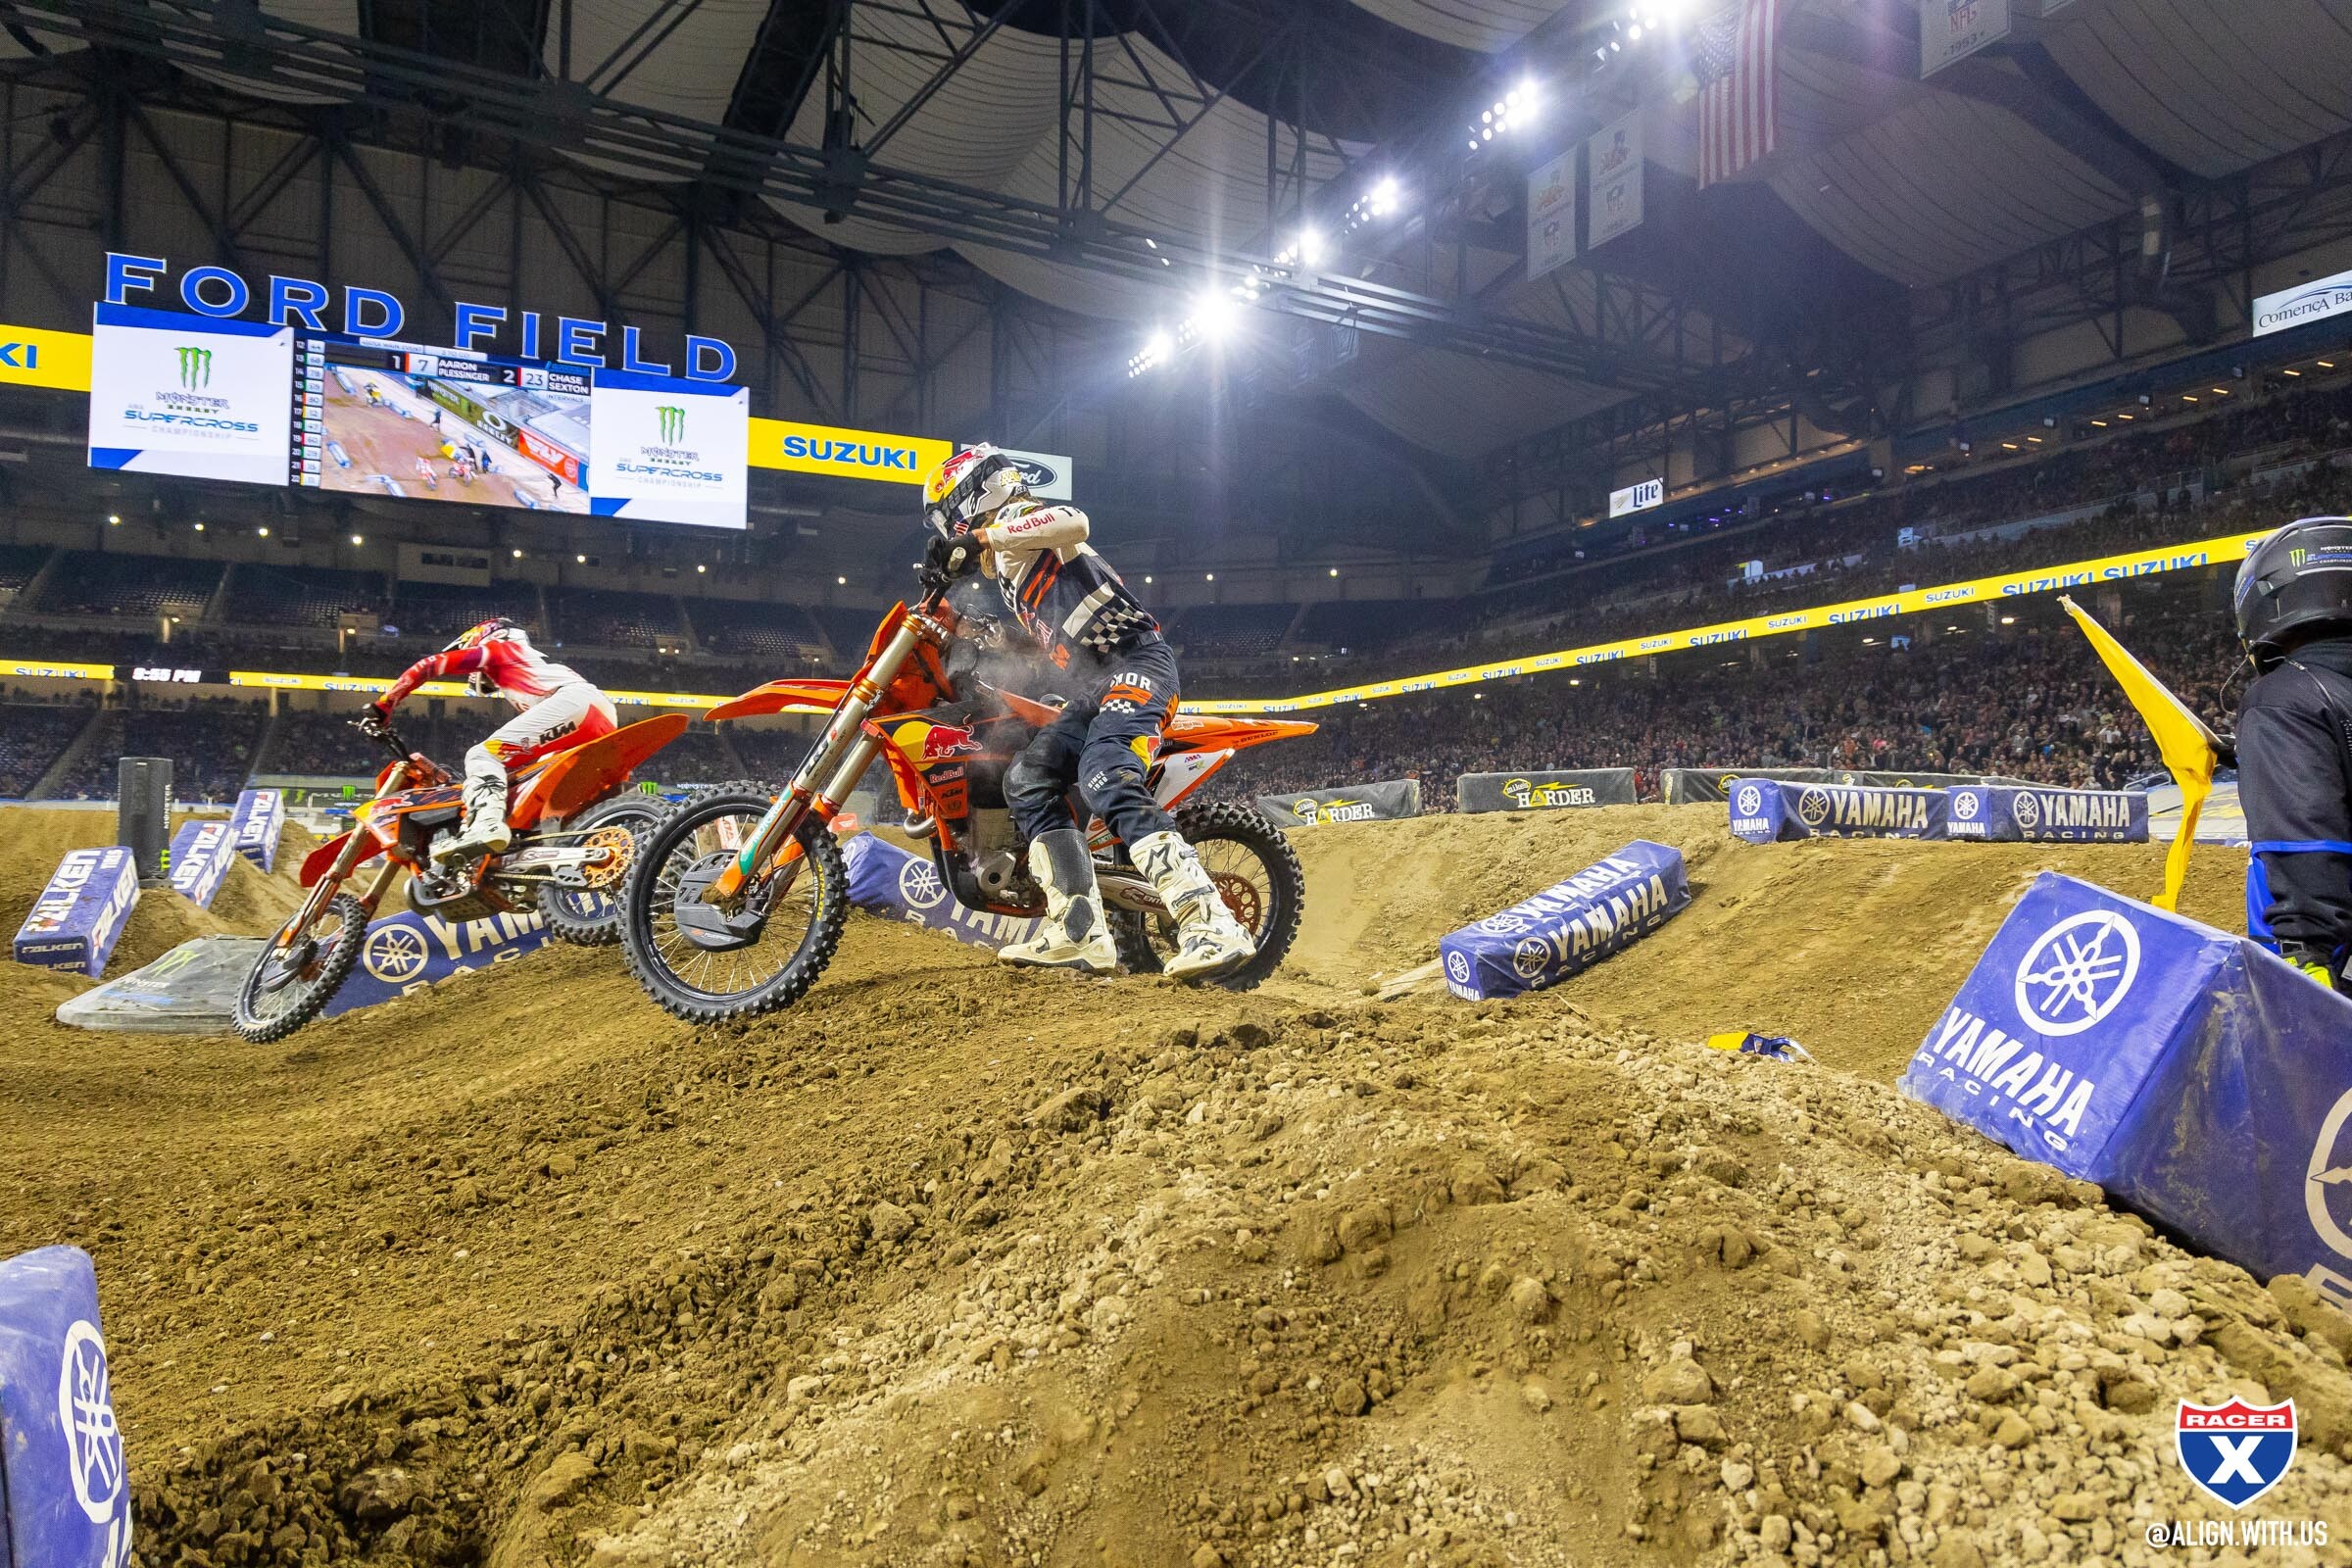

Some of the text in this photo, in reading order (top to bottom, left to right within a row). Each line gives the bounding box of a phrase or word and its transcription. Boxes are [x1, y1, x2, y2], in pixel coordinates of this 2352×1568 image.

[105, 252, 737, 383] FORD FIELD
[393, 356, 477, 372] 1 7 AARON
[439, 368, 490, 382] PLESSINGER
[503, 370, 582, 386] 2 23 CHASE
[549, 382, 588, 394] SEXTON
[155, 392, 231, 410] MONSTER
[123, 410, 259, 432] SUPERCROSS
[151, 425, 232, 440] CHAMPIONSHIP
[641, 447, 700, 461] MONSTER
[783, 435, 917, 470] SUZUKI
[615, 463, 723, 482] SUPERCROSS
[638, 476, 702, 488] CHAMPIONSHIP
[1633, 484, 1658, 508] Lite
[1007, 514, 1055, 533] Red Bull
[2103, 553, 2207, 582] SUZUKI
[2001, 570, 2095, 596] SUZUKI
[1925, 586, 1976, 604] SUZUKI
[1768, 615, 1807, 629] SUZUKI
[1829, 604, 1902, 623] SUZUKI
[1641, 638, 1673, 650] SUZUKI
[1690, 629, 1748, 647] SUZUKI
[1536, 657, 1562, 666] SUZUKI
[1576, 650, 1625, 664] SUZUKI
[16, 668, 86, 678] SUZUKI
[1482, 667, 1522, 680] SUZUKI
[325, 682, 388, 693] SUZUKI
[539, 721, 577, 745] KTM
[929, 766, 964, 784] Red Bull
[1088, 770, 1105, 789] SINCE
[1093, 776, 1108, 792] 1968
[163, 784, 172, 830] MONSTER
[1517, 789, 1595, 808] HARDER
[240, 791, 276, 844] FALKEN
[1305, 804, 1376, 825] HARDER
[1833, 790, 1929, 829] YAMAHA
[2040, 794, 2131, 827] YAMAHA
[1733, 817, 1770, 832] YAMAHA
[1946, 821, 1985, 834] YAMAHA
[2023, 831, 2125, 840] RACING
[172, 823, 227, 890] FALKEN
[24, 850, 102, 932] FALKEN
[815, 858, 825, 921] DUNLOP
[1511, 858, 1641, 919] YAMAHA
[1547, 874, 1668, 962] YAMAHA
[22, 943, 84, 954] FALKEN
[1531, 914, 1662, 988] RACING
[1446, 978, 1480, 1002] YAMAHA
[1932, 1007, 2095, 1136] YAMAHA
[1917, 1053, 2070, 1152] RACING
